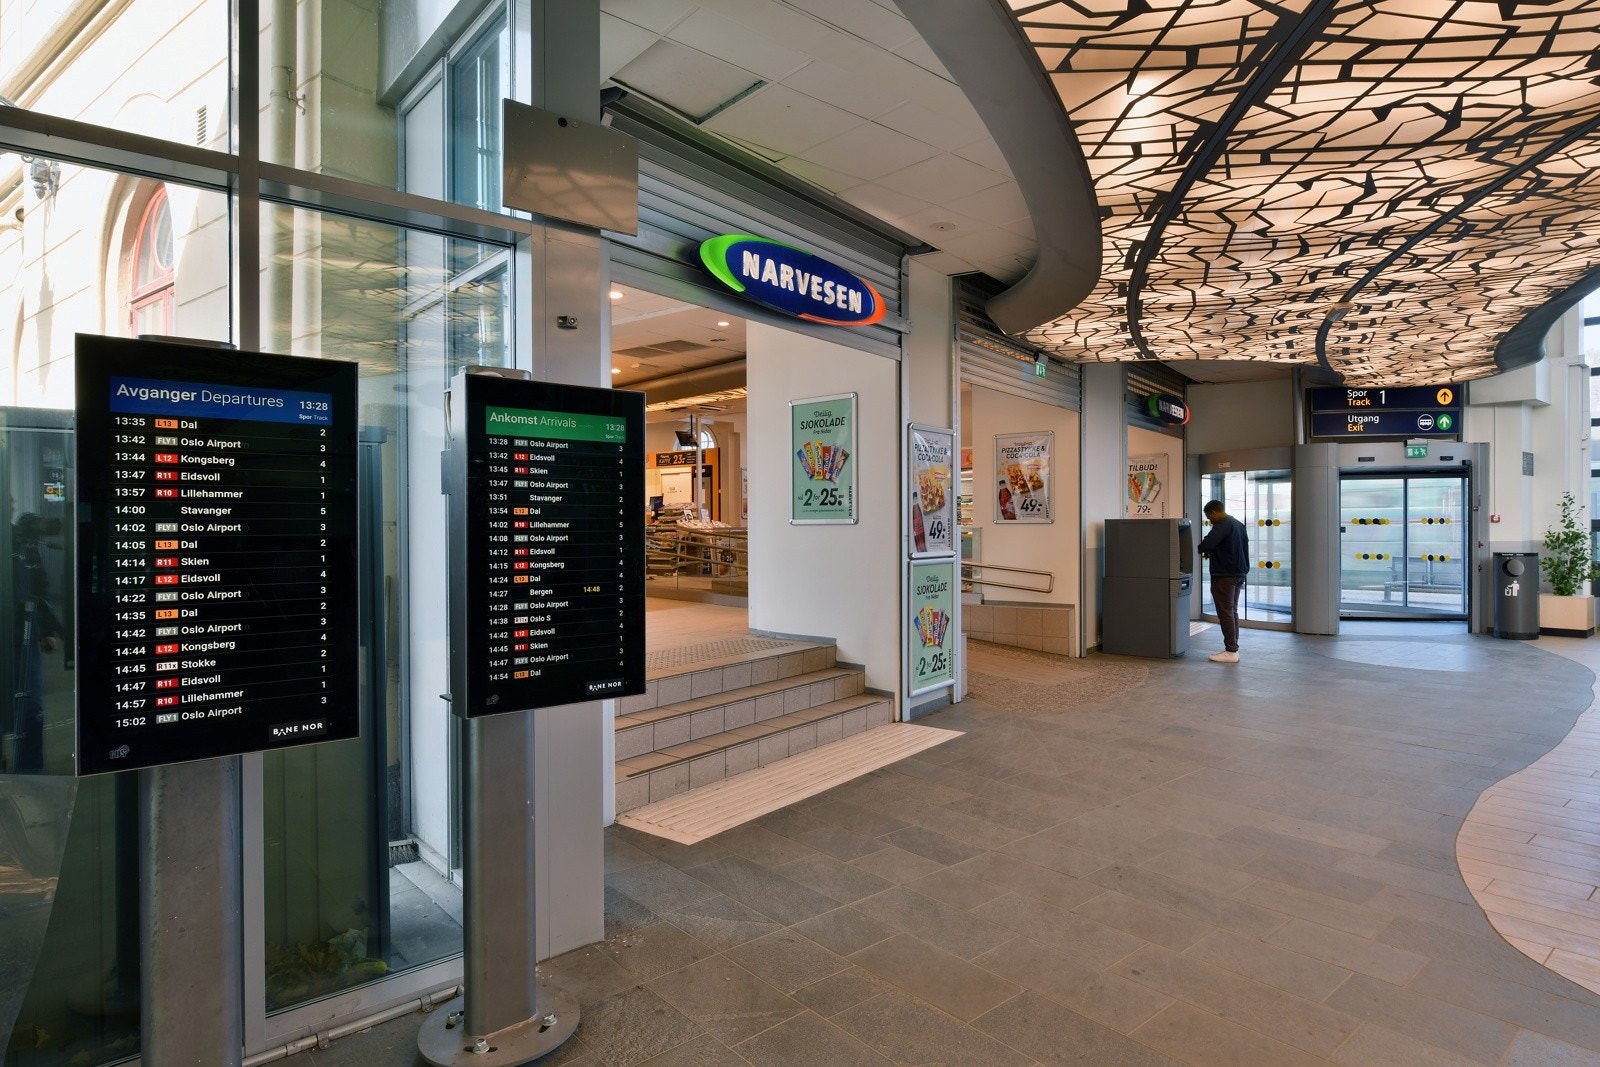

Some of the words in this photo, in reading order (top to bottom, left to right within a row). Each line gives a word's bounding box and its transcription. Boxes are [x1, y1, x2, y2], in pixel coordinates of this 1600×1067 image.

[742, 250, 862, 314] NARVESEN
[116, 383, 197, 402] Avganger
[201, 390, 284, 408] Departures
[300, 400, 328, 411] 13:28
[1348, 398, 1370, 406] Track
[1379, 390, 1385, 404] 1
[115, 417, 145, 426] 13:35
[181, 421, 197, 429] Dal
[490, 412, 537, 425] Ankomst
[540, 416, 577, 428] Arrivals
[606, 424, 624, 432] 13:28
[800, 417, 845, 430] SJOKOLADE
[1348, 415, 1379, 423] Utgang
[115, 435, 145, 443] 13:42
[181, 438, 204, 446] Oslo
[207, 440, 240, 449] Airport
[115, 453, 145, 461] 13:44
[181, 455, 234, 466] Kongsberg
[181, 472, 220, 480] Eidsvoll
[804, 489, 812, 506] 2
[181, 507, 231, 516] Stavanger
[207, 524, 241, 533] Airport
[116, 559, 145, 567] 14:14
[116, 577, 145, 585] 14:17
[182, 574, 220, 582] Eidsvoll
[916, 582, 947, 595] SJOKOLADE
[116, 594, 145, 603] 14:22
[181, 592, 204, 600] Oslo
[207, 591, 241, 600] Airport
[116, 612, 145, 620] 14:35
[182, 609, 197, 617] Dal
[116, 629, 145, 638] 14:42
[182, 626, 204, 634] Oslo
[207, 624, 241, 633] Airport
[530, 628, 555, 636] Eidsvoll
[116, 647, 145, 656] 14:44
[182, 641, 235, 651] Kongsberg
[116, 665, 145, 674] 14:45
[182, 659, 216, 668] Stokke
[489, 659, 508, 667] 14:47
[547, 654, 568, 662] Airport
[919, 657, 926, 676] 2
[116, 682, 145, 692] 14:47
[182, 675, 220, 685] Eidsvoll
[116, 700, 145, 709] 14:57
[182, 691, 243, 703] Lillehammer
[116, 717, 146, 727] 15:02
[182, 711, 204, 720] Oslo
[208, 707, 242, 717] Airport
[302, 722, 323, 731] NOR
